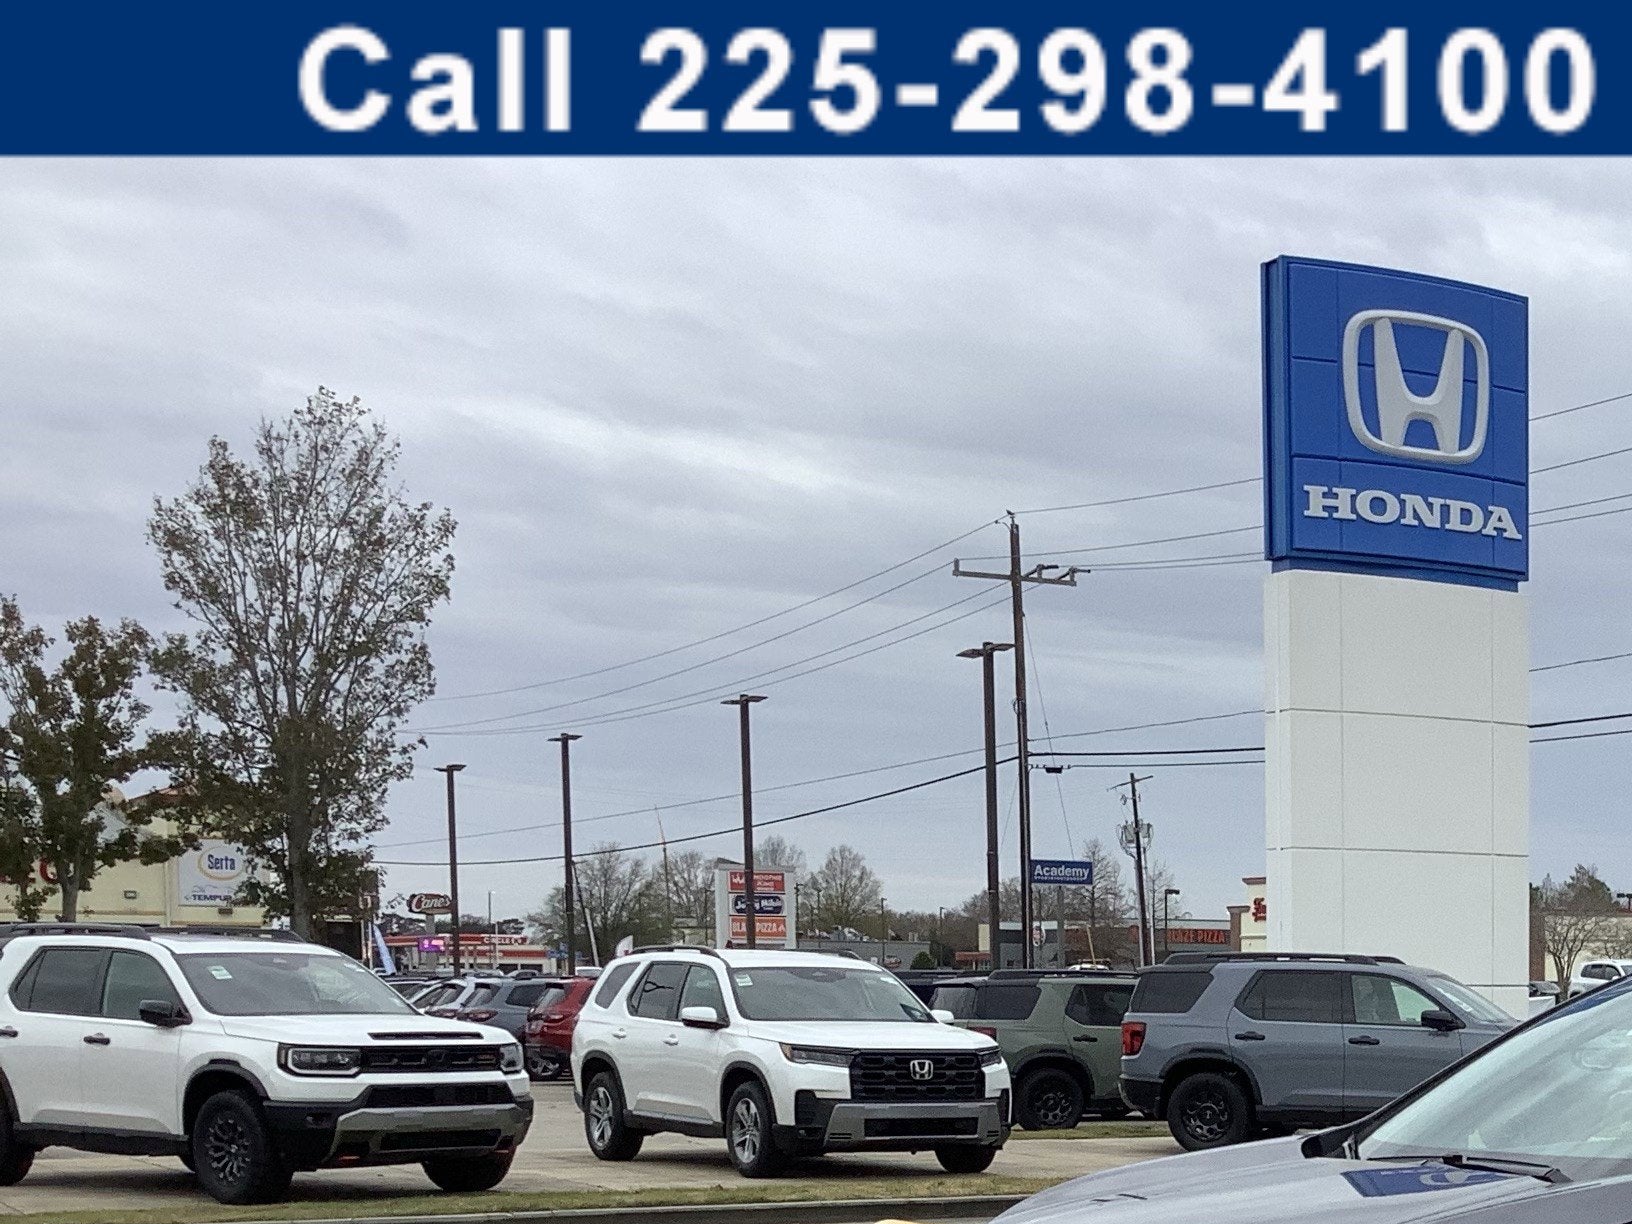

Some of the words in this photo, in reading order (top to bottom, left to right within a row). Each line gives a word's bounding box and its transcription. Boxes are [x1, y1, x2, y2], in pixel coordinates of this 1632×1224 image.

[1303, 484, 1522, 540] HONDA
[207, 854, 236, 871] Serta
[1034, 864, 1090, 880] Academy
[412, 894, 451, 913] Cane's
[1198, 930, 1225, 943] PIZZA
